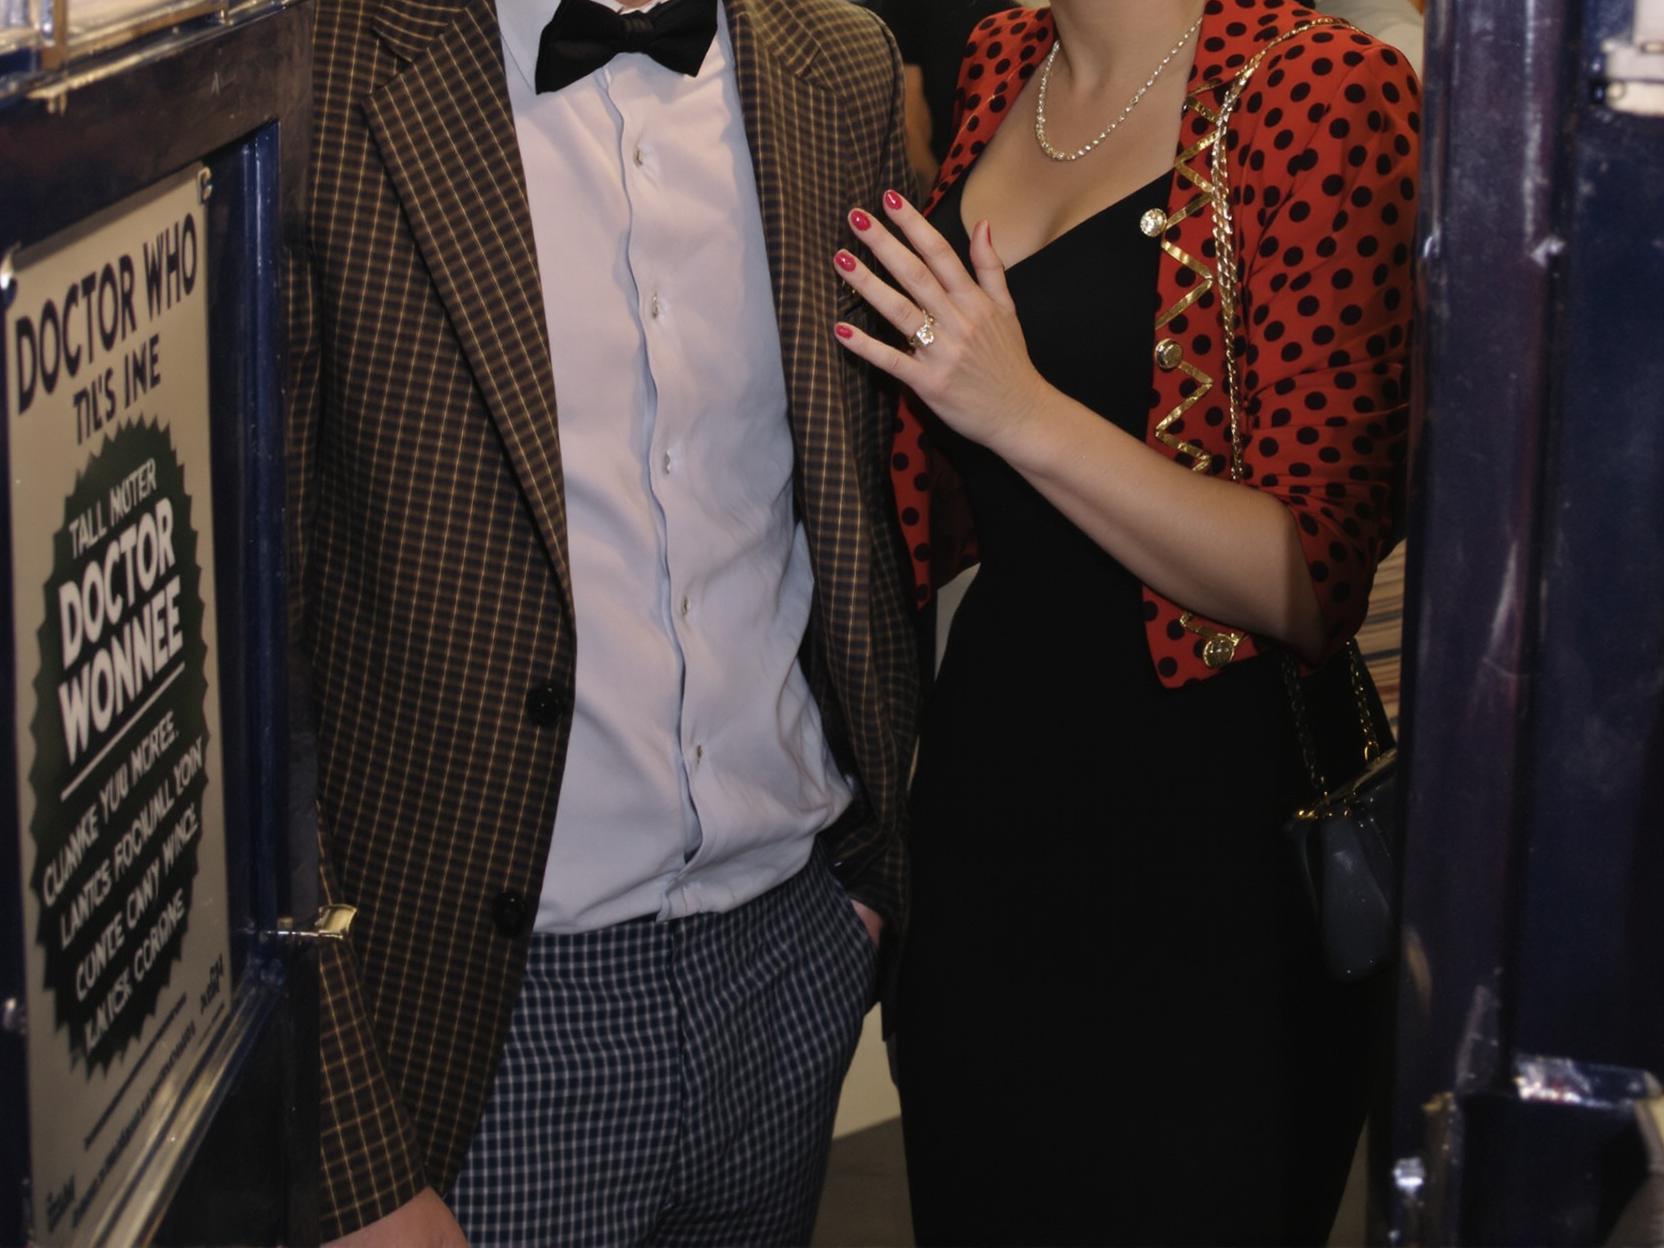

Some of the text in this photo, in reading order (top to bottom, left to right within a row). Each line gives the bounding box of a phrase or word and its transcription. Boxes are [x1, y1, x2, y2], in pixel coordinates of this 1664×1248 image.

[16, 212, 197, 415] DOCTOR WHO
[58, 497, 175, 671] DOCTOR
[69, 500, 107, 559] TALL
[58, 575, 183, 766] WONNEE
